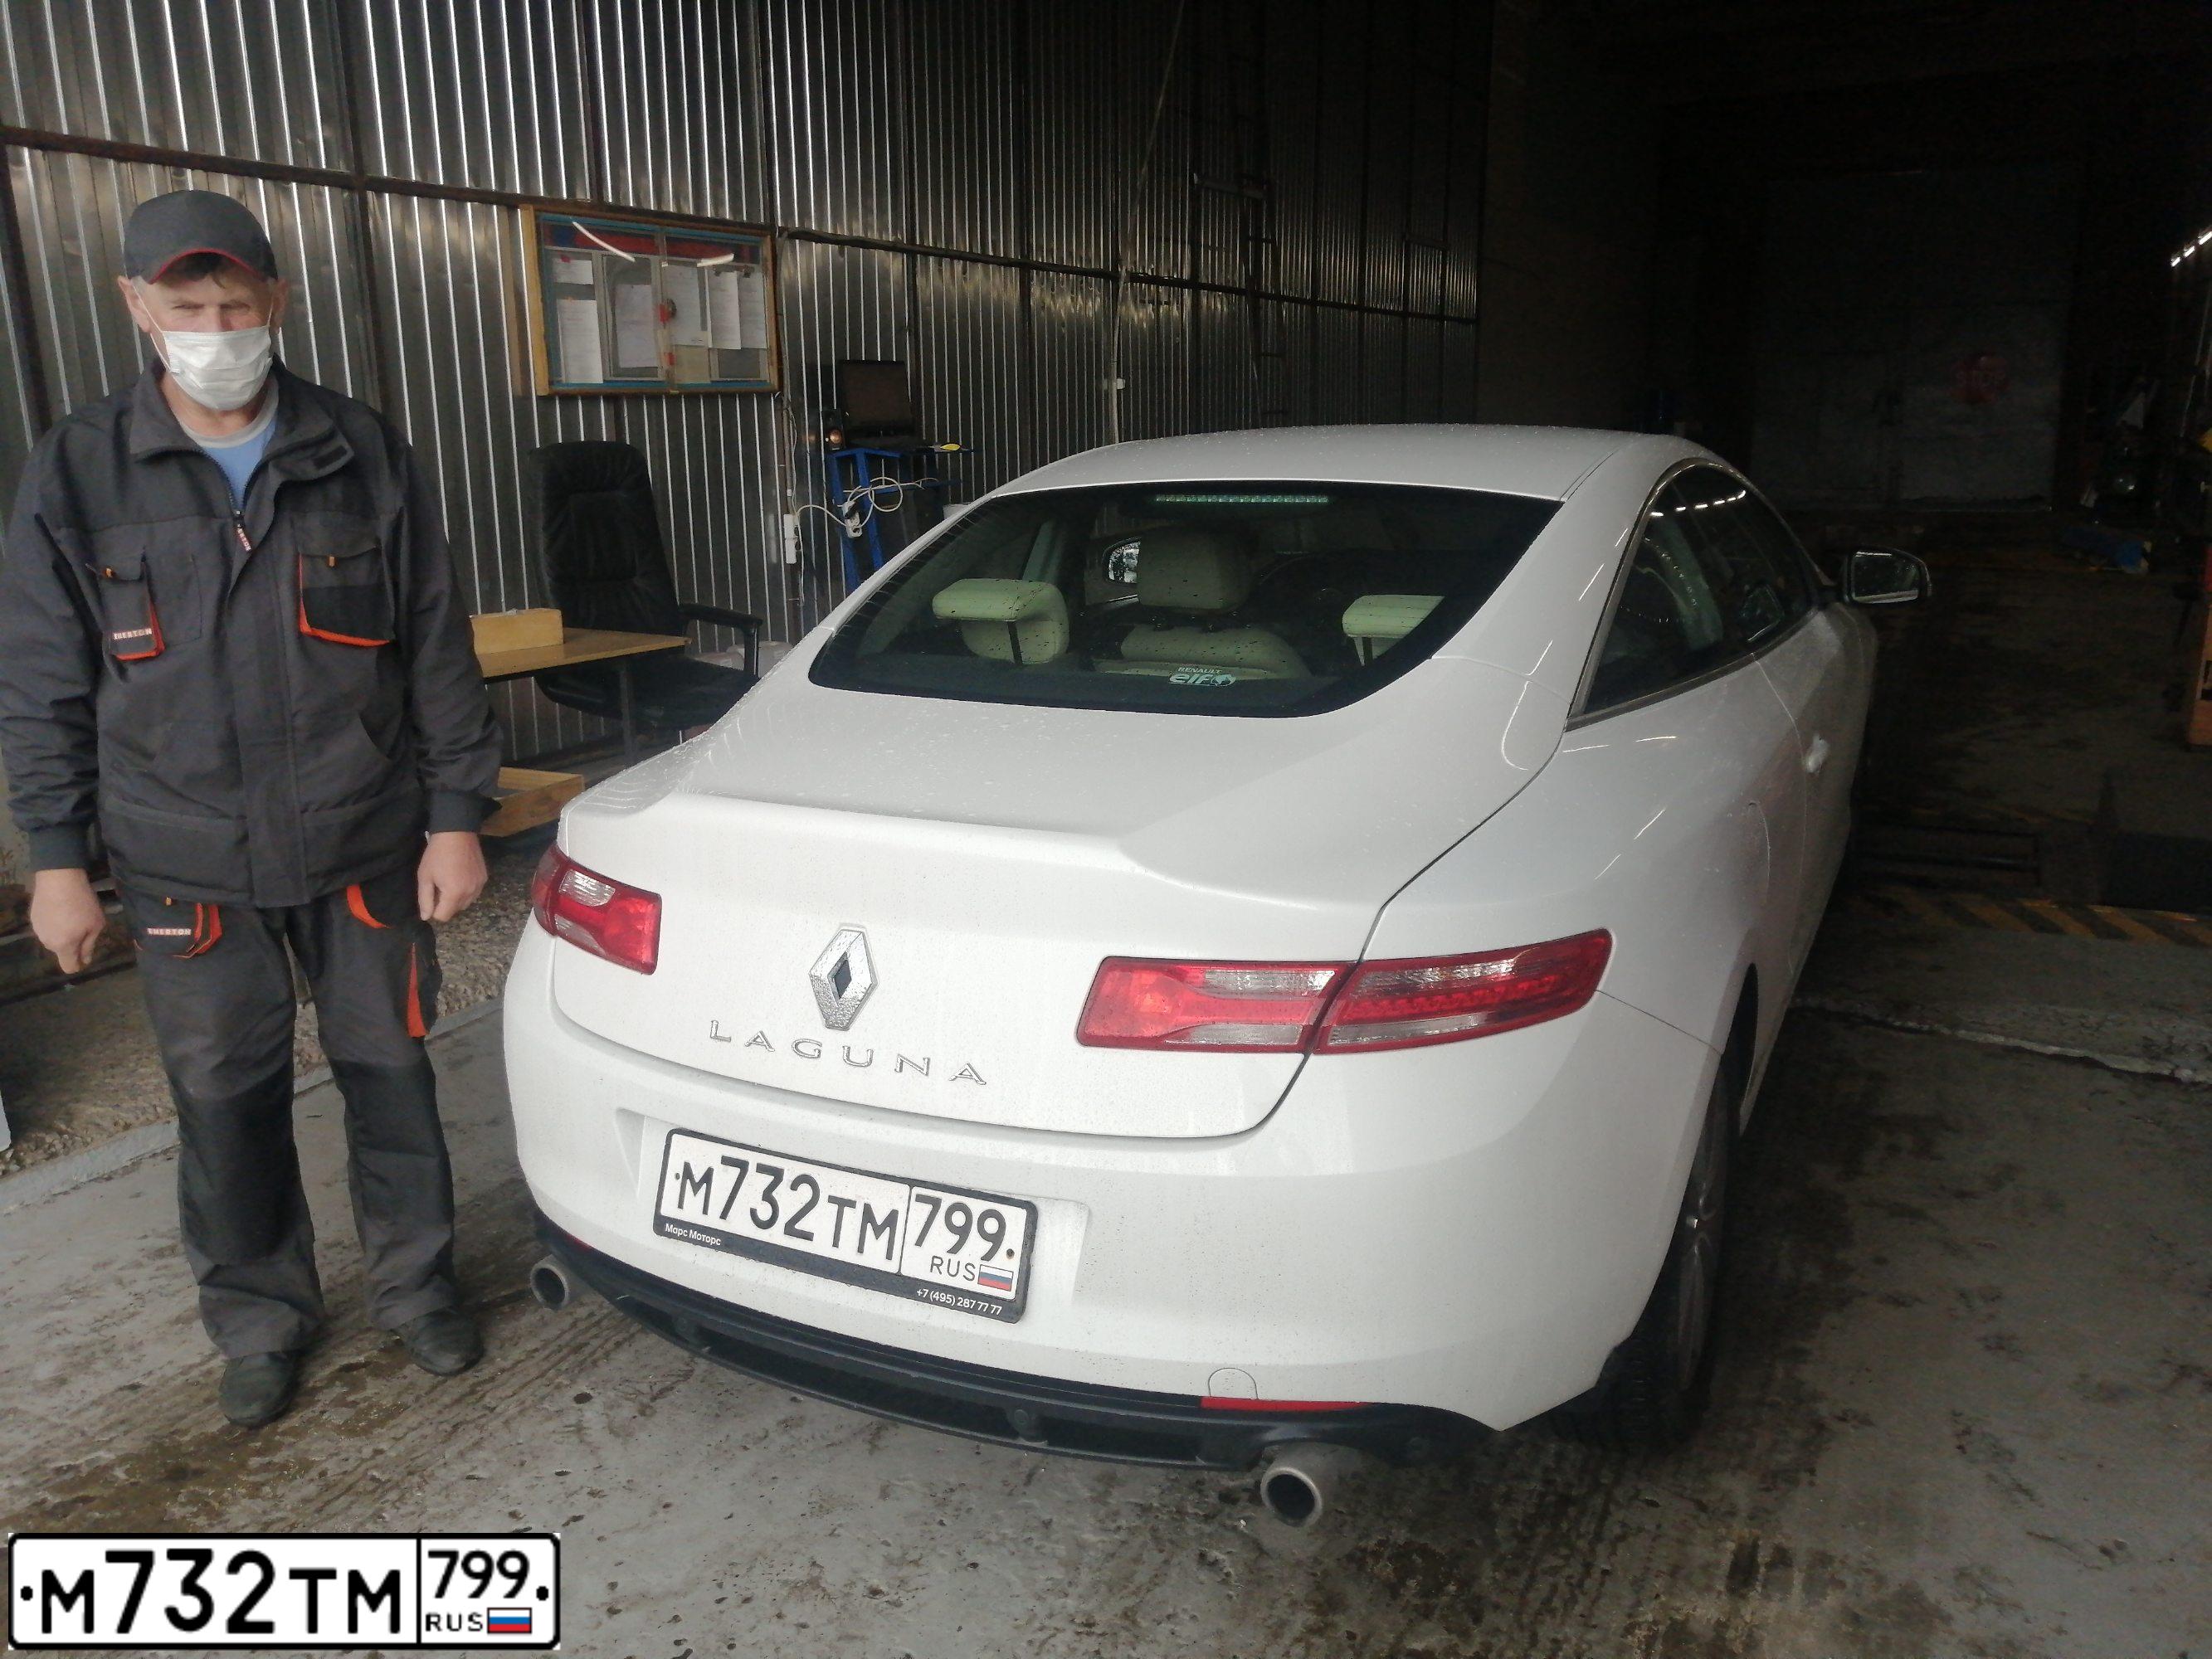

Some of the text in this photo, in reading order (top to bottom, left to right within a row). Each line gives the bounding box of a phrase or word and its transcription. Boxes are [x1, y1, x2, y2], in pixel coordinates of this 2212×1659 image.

[709, 1019, 987, 1086] LAGUNA
[676, 1155, 899, 1261] М732ТМ
[914, 1193, 1006, 1262] 799
[665, 1224, 721, 1246] Марс Моторс
[929, 1255, 976, 1282] RUS
[916, 1289, 1002, 1316] +7 (495) 287 77 77
